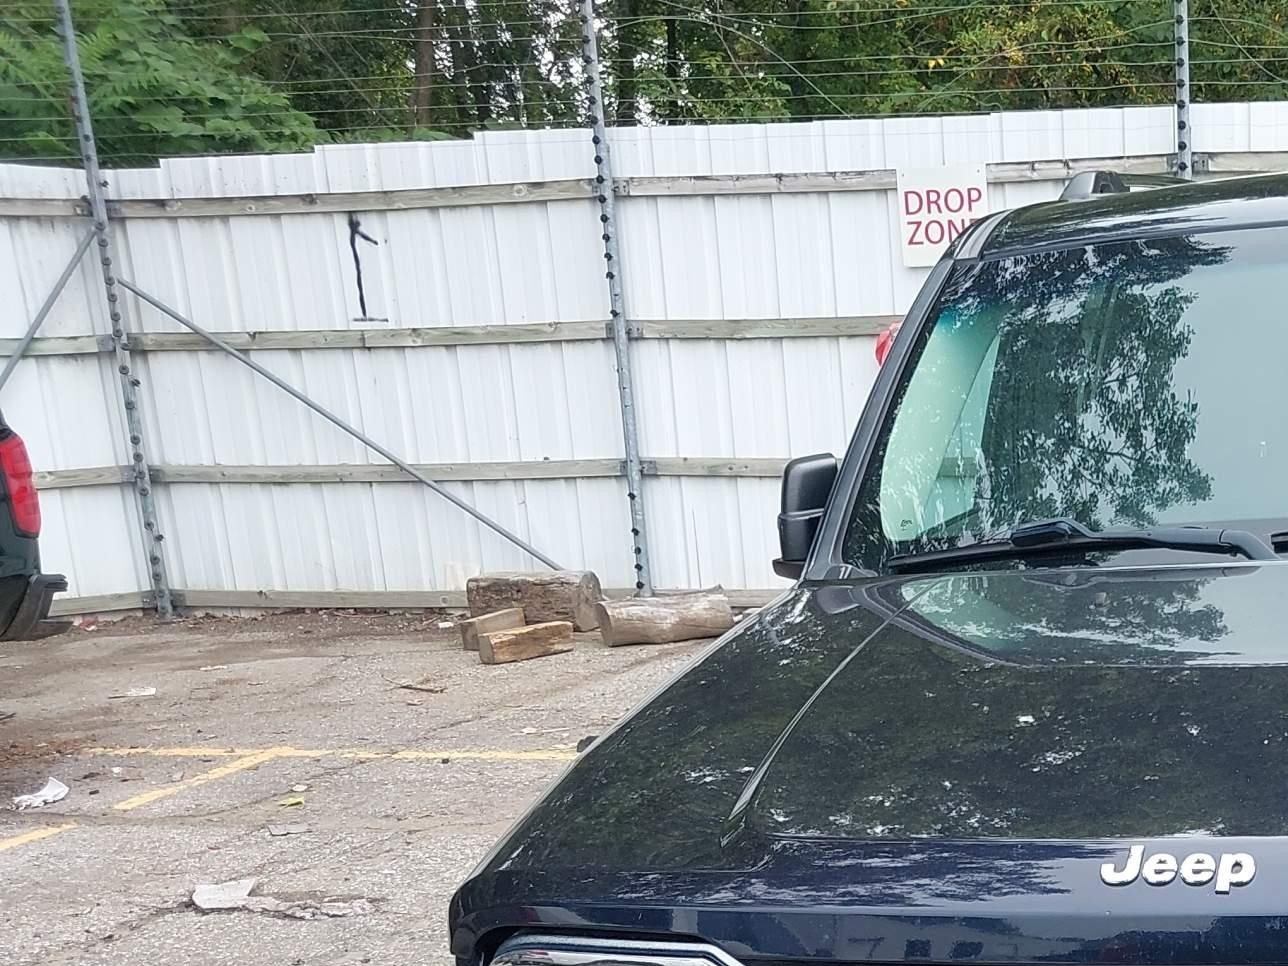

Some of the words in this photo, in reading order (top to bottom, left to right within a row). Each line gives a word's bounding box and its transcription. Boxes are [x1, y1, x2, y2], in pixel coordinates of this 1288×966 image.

[903, 187, 982, 216] DROP
[906, 218, 981, 246] ZON
[1100, 844, 1257, 895] Jeep
